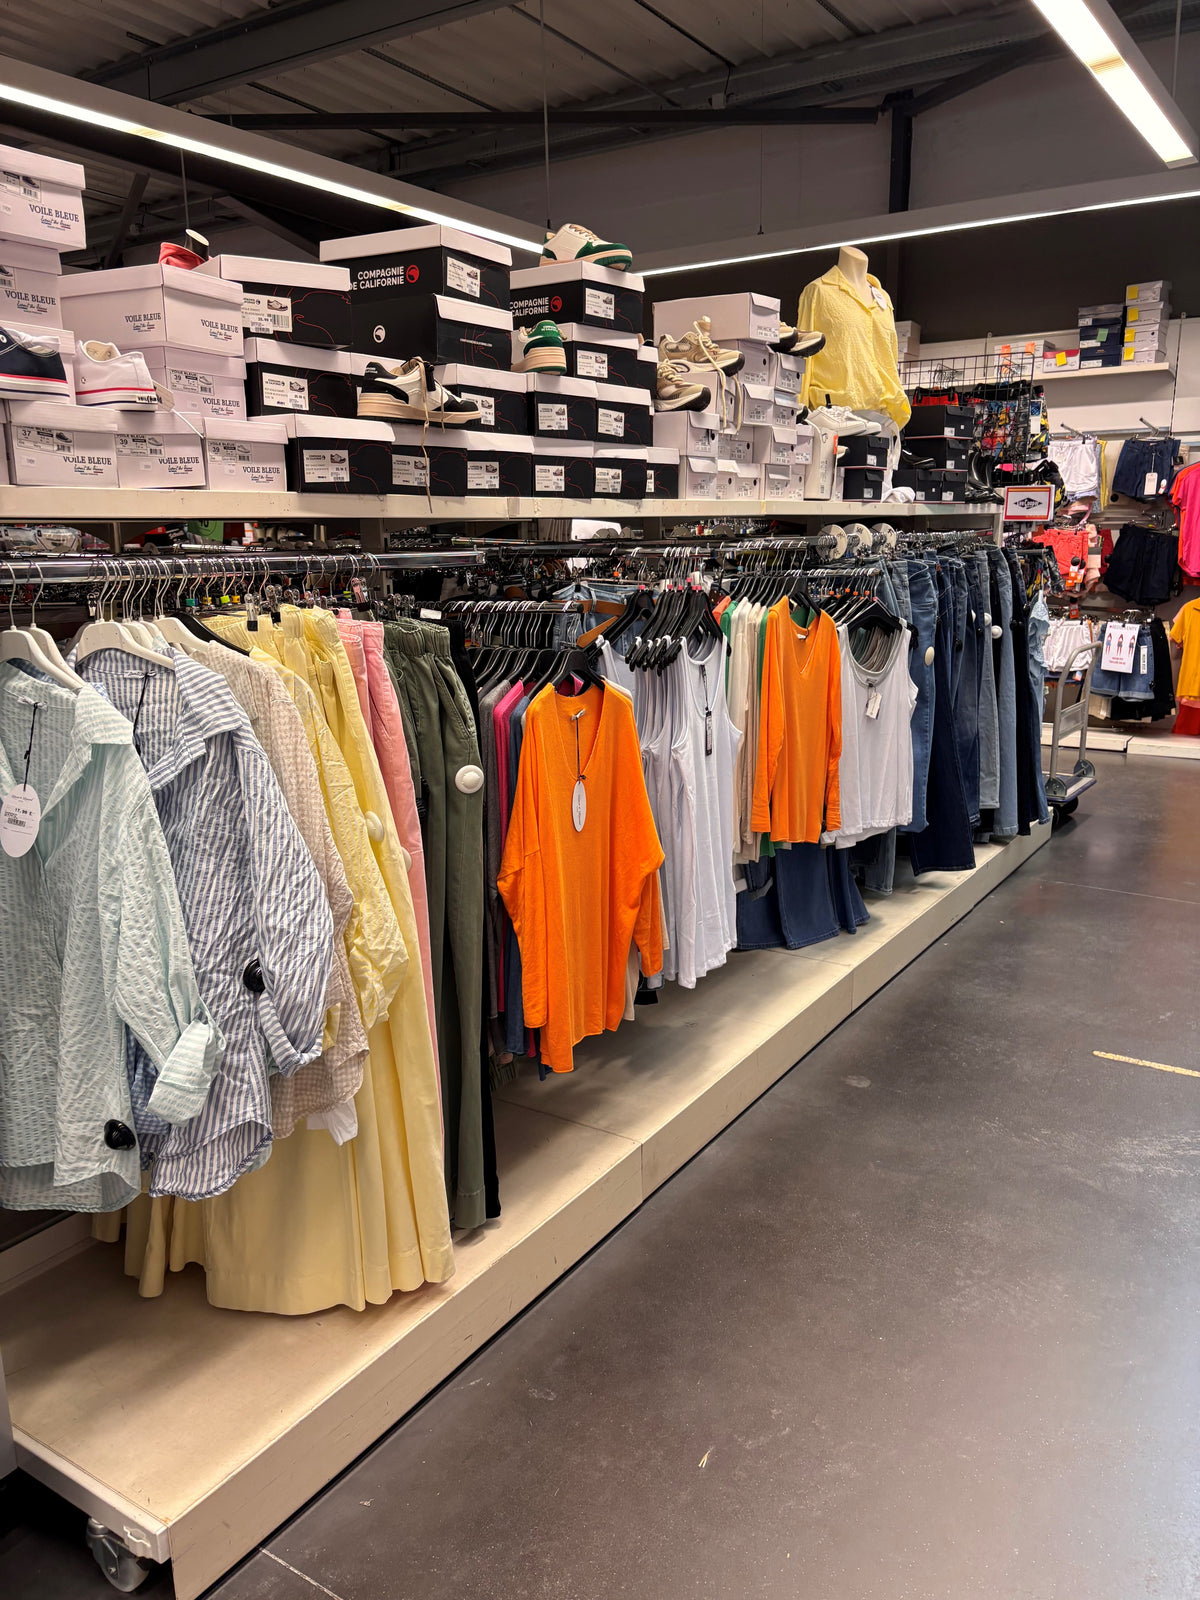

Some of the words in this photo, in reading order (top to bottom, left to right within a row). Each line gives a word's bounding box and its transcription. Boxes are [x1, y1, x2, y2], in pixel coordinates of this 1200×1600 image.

[29, 204, 53, 217] VOILE
[55, 209, 79, 222] BLEUE
[357, 266, 404, 281] COMPAGNIE
[360, 276, 404, 290] CALIFORNIE
[5, 290, 30, 301] VOILE
[31, 294, 56, 305] BLEUE
[125, 314, 142, 323] VOILE
[143, 312, 161, 321] BLEUE
[201, 319, 219, 329] VOILE
[220, 323, 239, 333] BLEUE
[202, 397, 221, 406] VOILE
[221, 399, 240, 408] BLEUE
[22, 429, 32, 437] 37
[63, 455, 87, 464] VOILE
[88, 456, 112, 465] BLEUE
[158, 457, 178, 465] VOILE
[179, 456, 200, 465] BLEUE
[242, 466, 261, 474] VOILE
[261, 466, 281, 474] BLEUE
